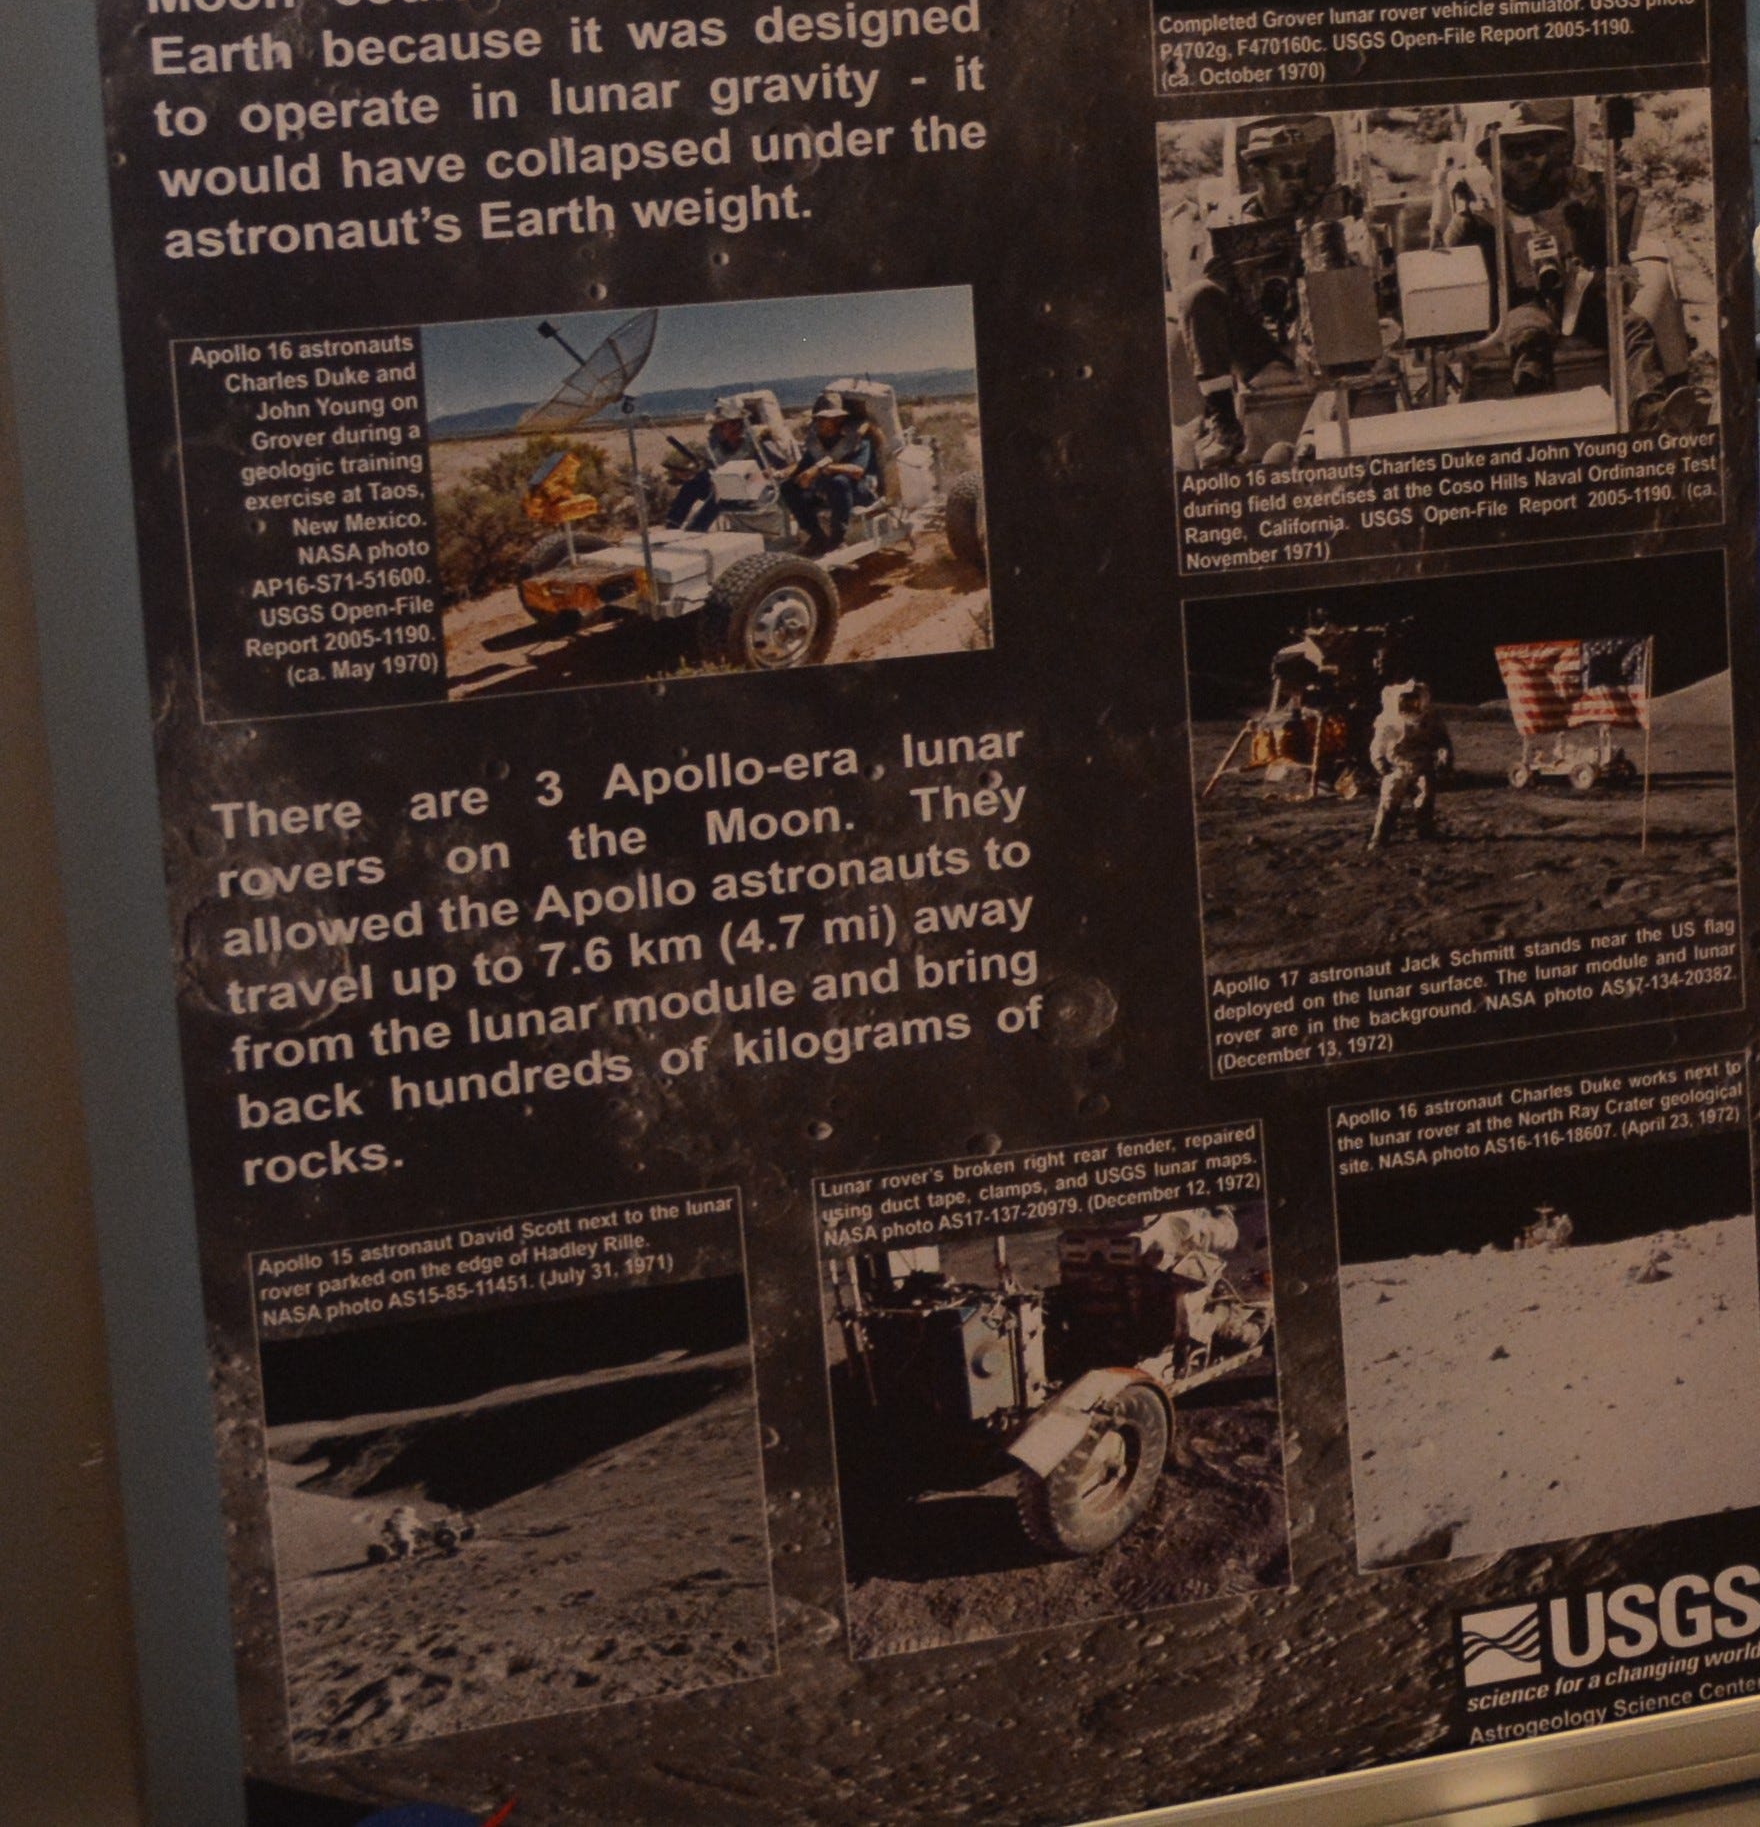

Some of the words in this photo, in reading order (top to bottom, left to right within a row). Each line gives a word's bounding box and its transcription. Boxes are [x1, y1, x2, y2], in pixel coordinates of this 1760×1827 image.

[150, 31, 292, 75] Earth
[322, 27, 542, 68] because
[570, 16, 603, 54] it
[627, 17, 727, 50] was
[1158, 11, 1257, 36] Completed
[1262, 9, 1324, 28] Grover
[1329, 7, 1375, 24] lunar
[1379, 6, 1427, 21] rover
[1431, 0, 1495, 18] vehicle
[240, 459, 334, 486] geologic
[339, 453, 423, 474] training
[244, 489, 336, 511] exercise
[341, 484, 362, 504] at
[367, 481, 424, 501] Taos,
[1183, 500, 1242, 519] during
[1247, 493, 1286, 512] field
[1292, 484, 1377, 509] exercises
[1382, 484, 1399, 501] at
[1404, 481, 1432, 499] the
[1438, 477, 1485, 496] Coso
[1490, 472, 1528, 490] Hills
[1534, 467, 1582, 487] Naval
[1587, 461, 1676, 482] Ordinance
[1681, 454, 1716, 473] Test
[292, 517, 339, 536] New
[344, 510, 427, 532] Mexico.
[298, 542, 362, 564] NASA
[367, 538, 430, 564] photo
[218, 855, 385, 899] rovers
[445, 841, 510, 875] on
[567, 822, 647, 861] the
[705, 805, 854, 845] Moon.
[909, 780, 1026, 823] They
[223, 900, 423, 957] allowed
[438, 894, 519, 933] the
[534, 872, 696, 926] Apollo
[712, 843, 971, 901] astronauts
[983, 836, 1031, 871] to
[1216, 1046, 1311, 1073] (December
[1317, 1039, 1342, 1057] 13,
[1347, 1033, 1393, 1053] 1972)
[1336, 1107, 1391, 1130] Apollo
[1398, 1102, 1418, 1119] 16
[1424, 1092, 1503, 1116] astronaut
[1510, 1084, 1573, 1104] Charles
[1580, 1077, 1622, 1095] Duke
[1628, 1069, 1677, 1088] works
[1684, 1062, 1719, 1081] next
[1724, 1060, 1742, 1077] to
[243, 1139, 403, 1186] rocks.
[821, 1203, 873, 1229] using
[880, 1194, 920, 1214] duct
[926, 1190, 971, 1209] tape,
[978, 1180, 1047, 1201] clamps,
[1054, 1171, 1088, 1191] and
[1094, 1162, 1147, 1185] USGS
[1153, 1159, 1198, 1176] lunar
[1205, 1151, 1258, 1170] maps.
[257, 1253, 323, 1277] Apollo
[330, 1247, 353, 1265] 15
[359, 1234, 452, 1262] astronaut
[459, 1224, 514, 1248] David
[520, 1217, 571, 1244] Scott
[577, 1211, 618, 1231] next
[623, 1209, 643, 1224] to
[648, 1204, 679, 1221] the
[685, 1197, 733, 1216] lunar
[1467, 1683, 1550, 1712] science
[1554, 1676, 1584, 1695] for
[1587, 1674, 1601, 1689] a
[1604, 1655, 1700, 1686] changing
[1468, 1704, 1608, 1746] Astrogeology
[1613, 1688, 1693, 1718] Science
